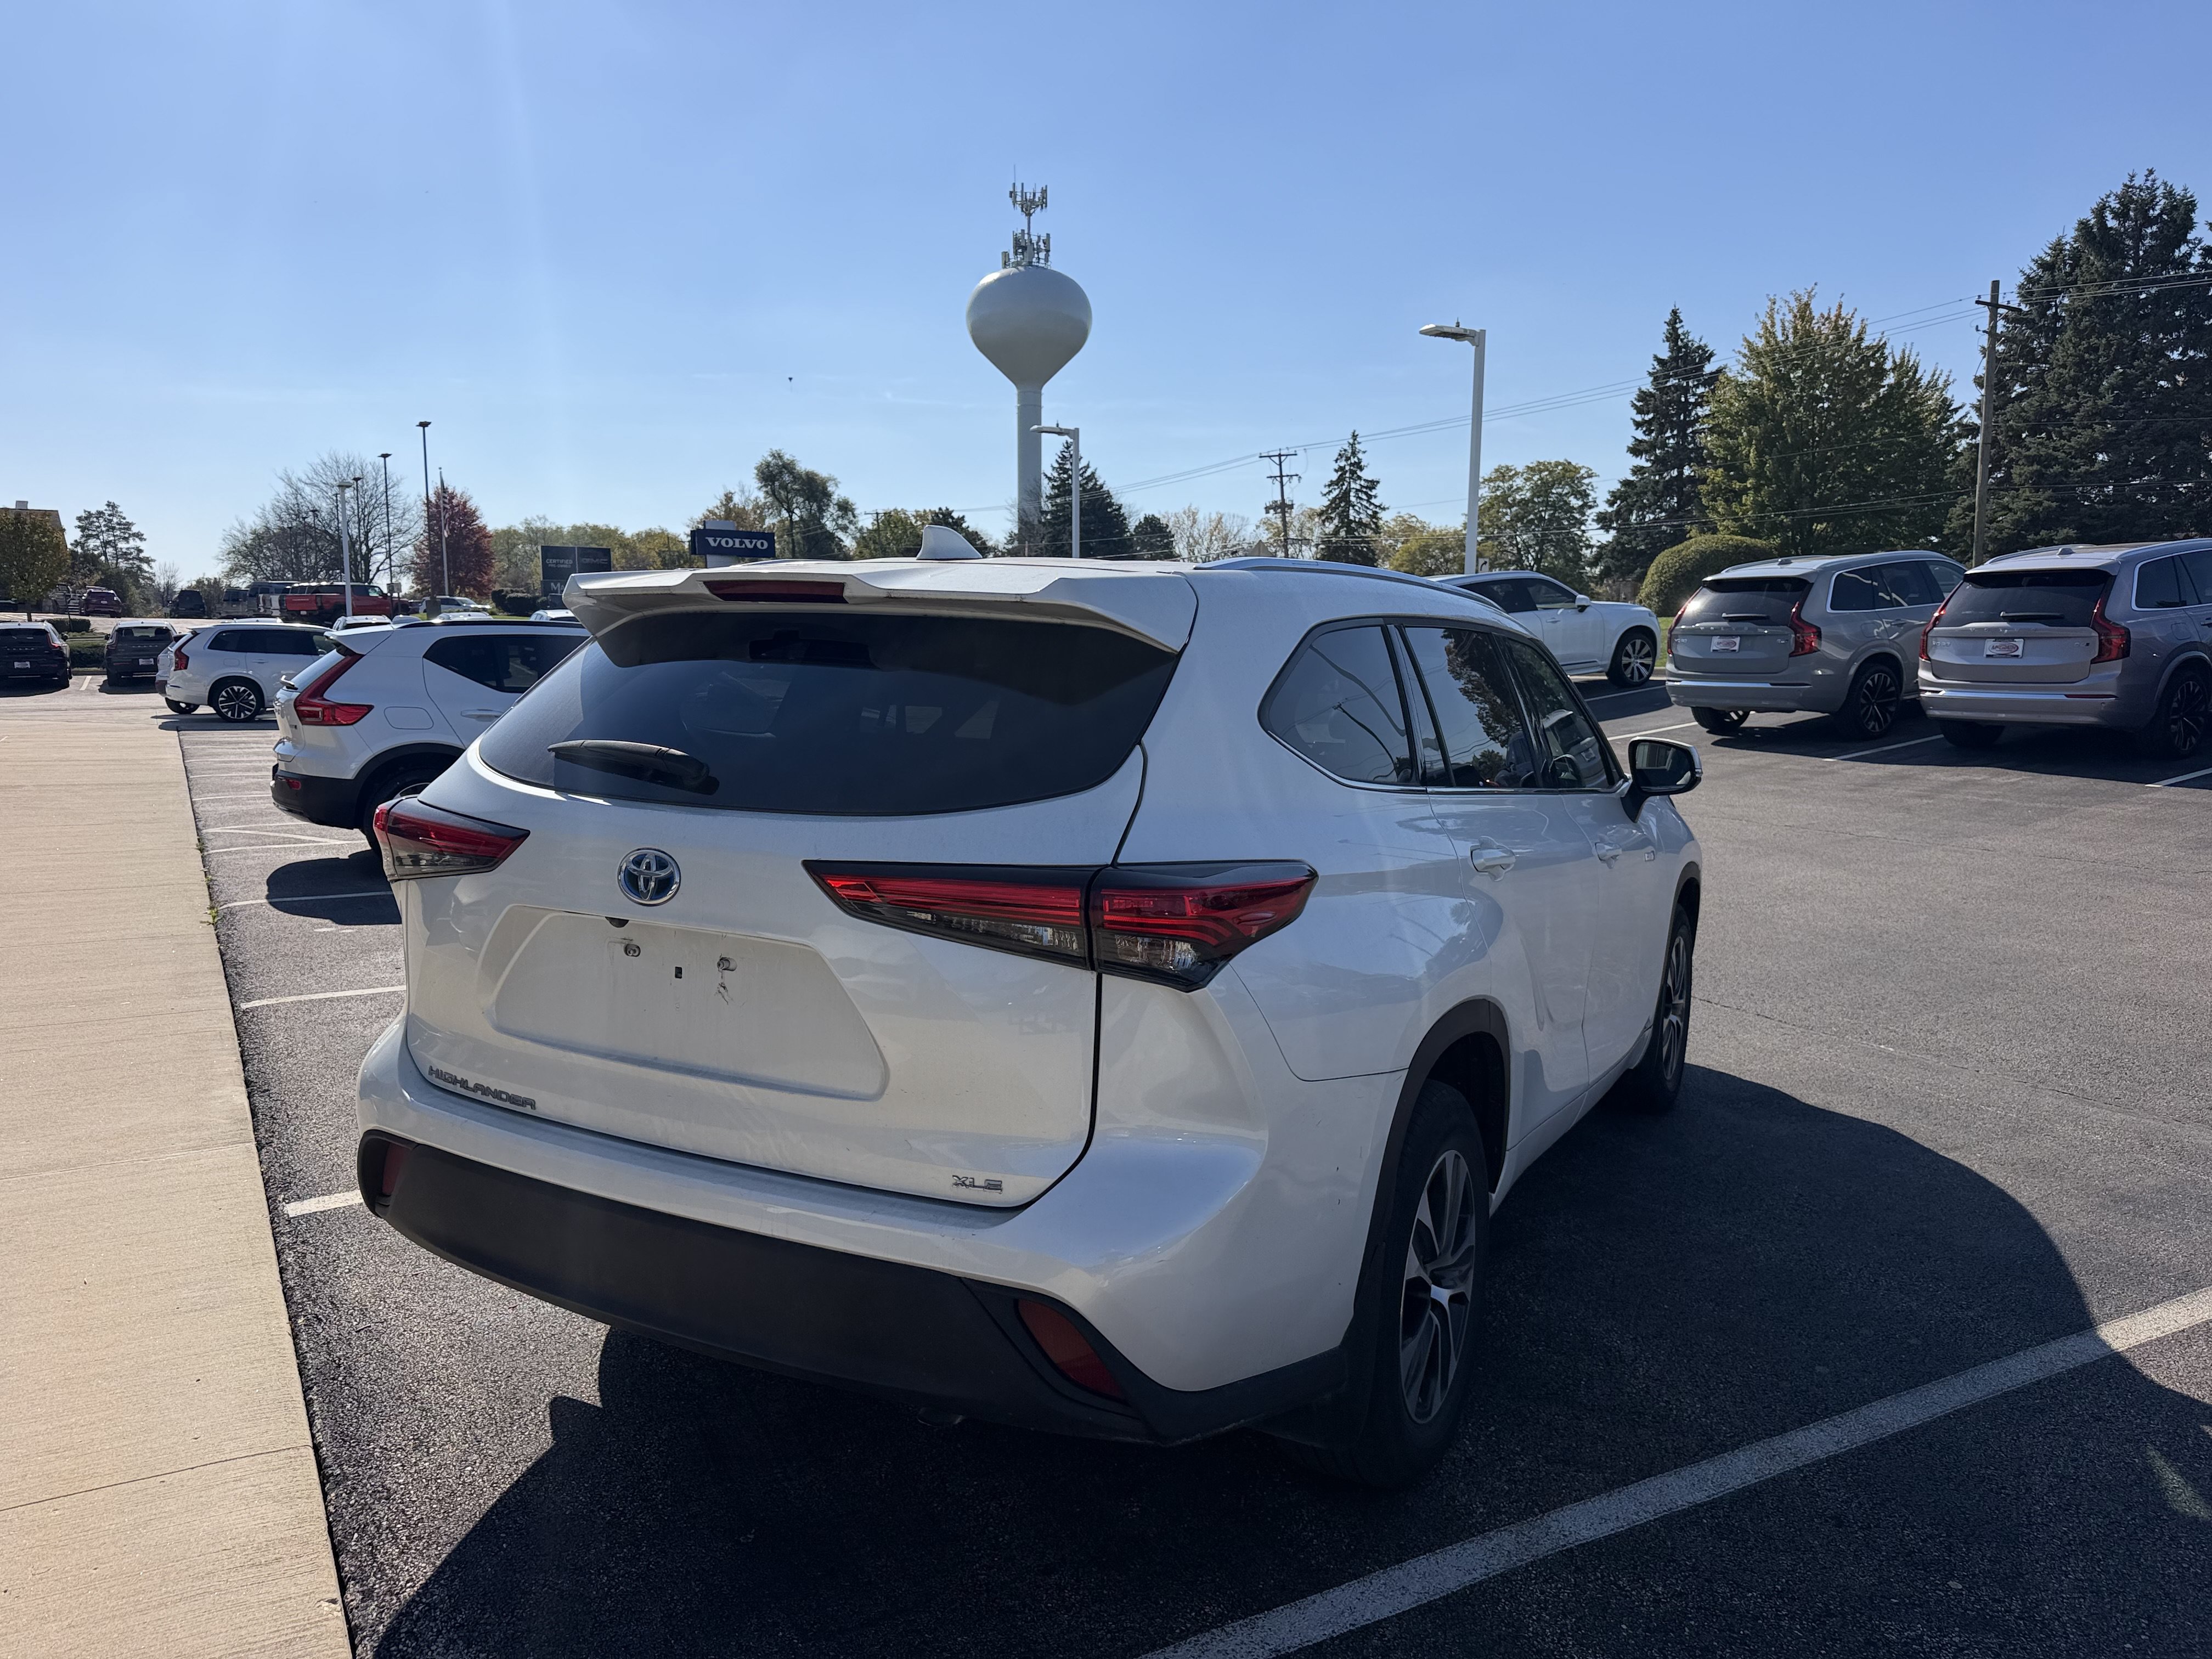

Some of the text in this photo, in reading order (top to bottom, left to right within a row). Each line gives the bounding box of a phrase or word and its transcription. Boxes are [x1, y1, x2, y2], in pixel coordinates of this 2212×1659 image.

[705, 537, 768, 549] VOLVO
[428, 1065, 537, 1110] HIGHLANDER
[952, 1175, 1003, 1193] XLE
